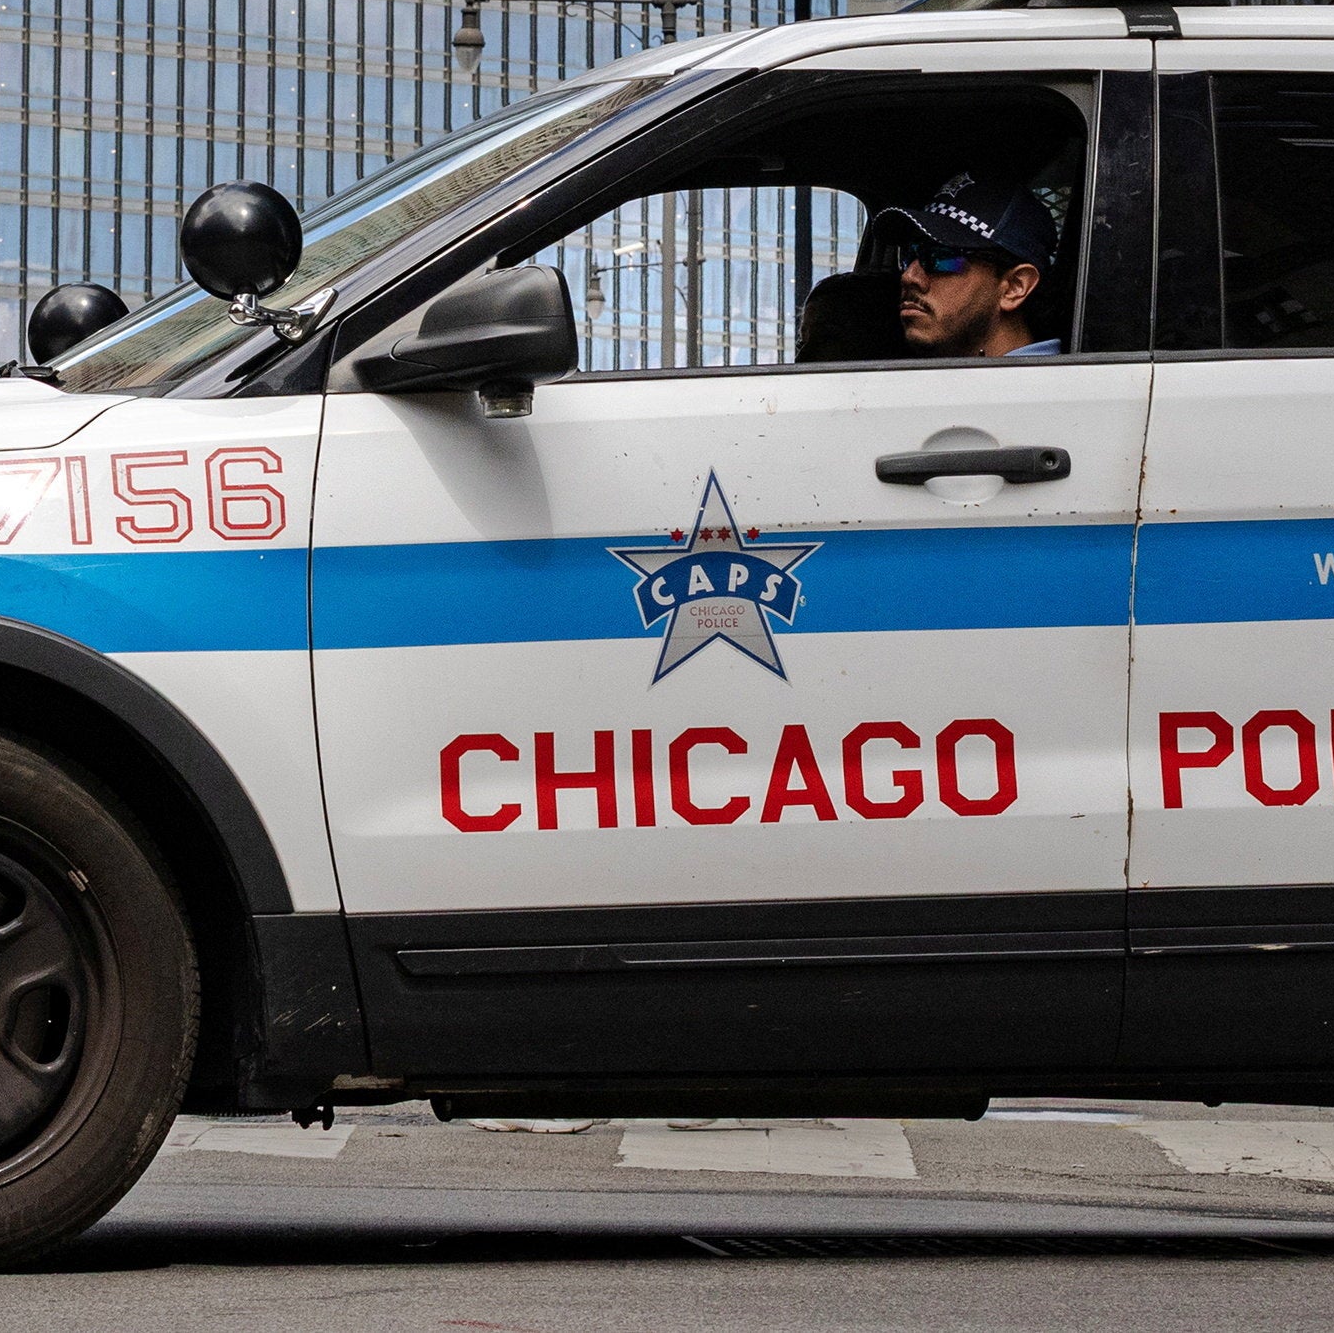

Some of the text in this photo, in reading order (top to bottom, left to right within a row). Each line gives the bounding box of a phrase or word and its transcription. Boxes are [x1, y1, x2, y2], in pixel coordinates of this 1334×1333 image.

[650, 562, 784, 607] CAPS
[689, 604, 746, 617] CHICAGO
[697, 618, 739, 629] POLICE
[440, 717, 1020, 834] CHICAGO
